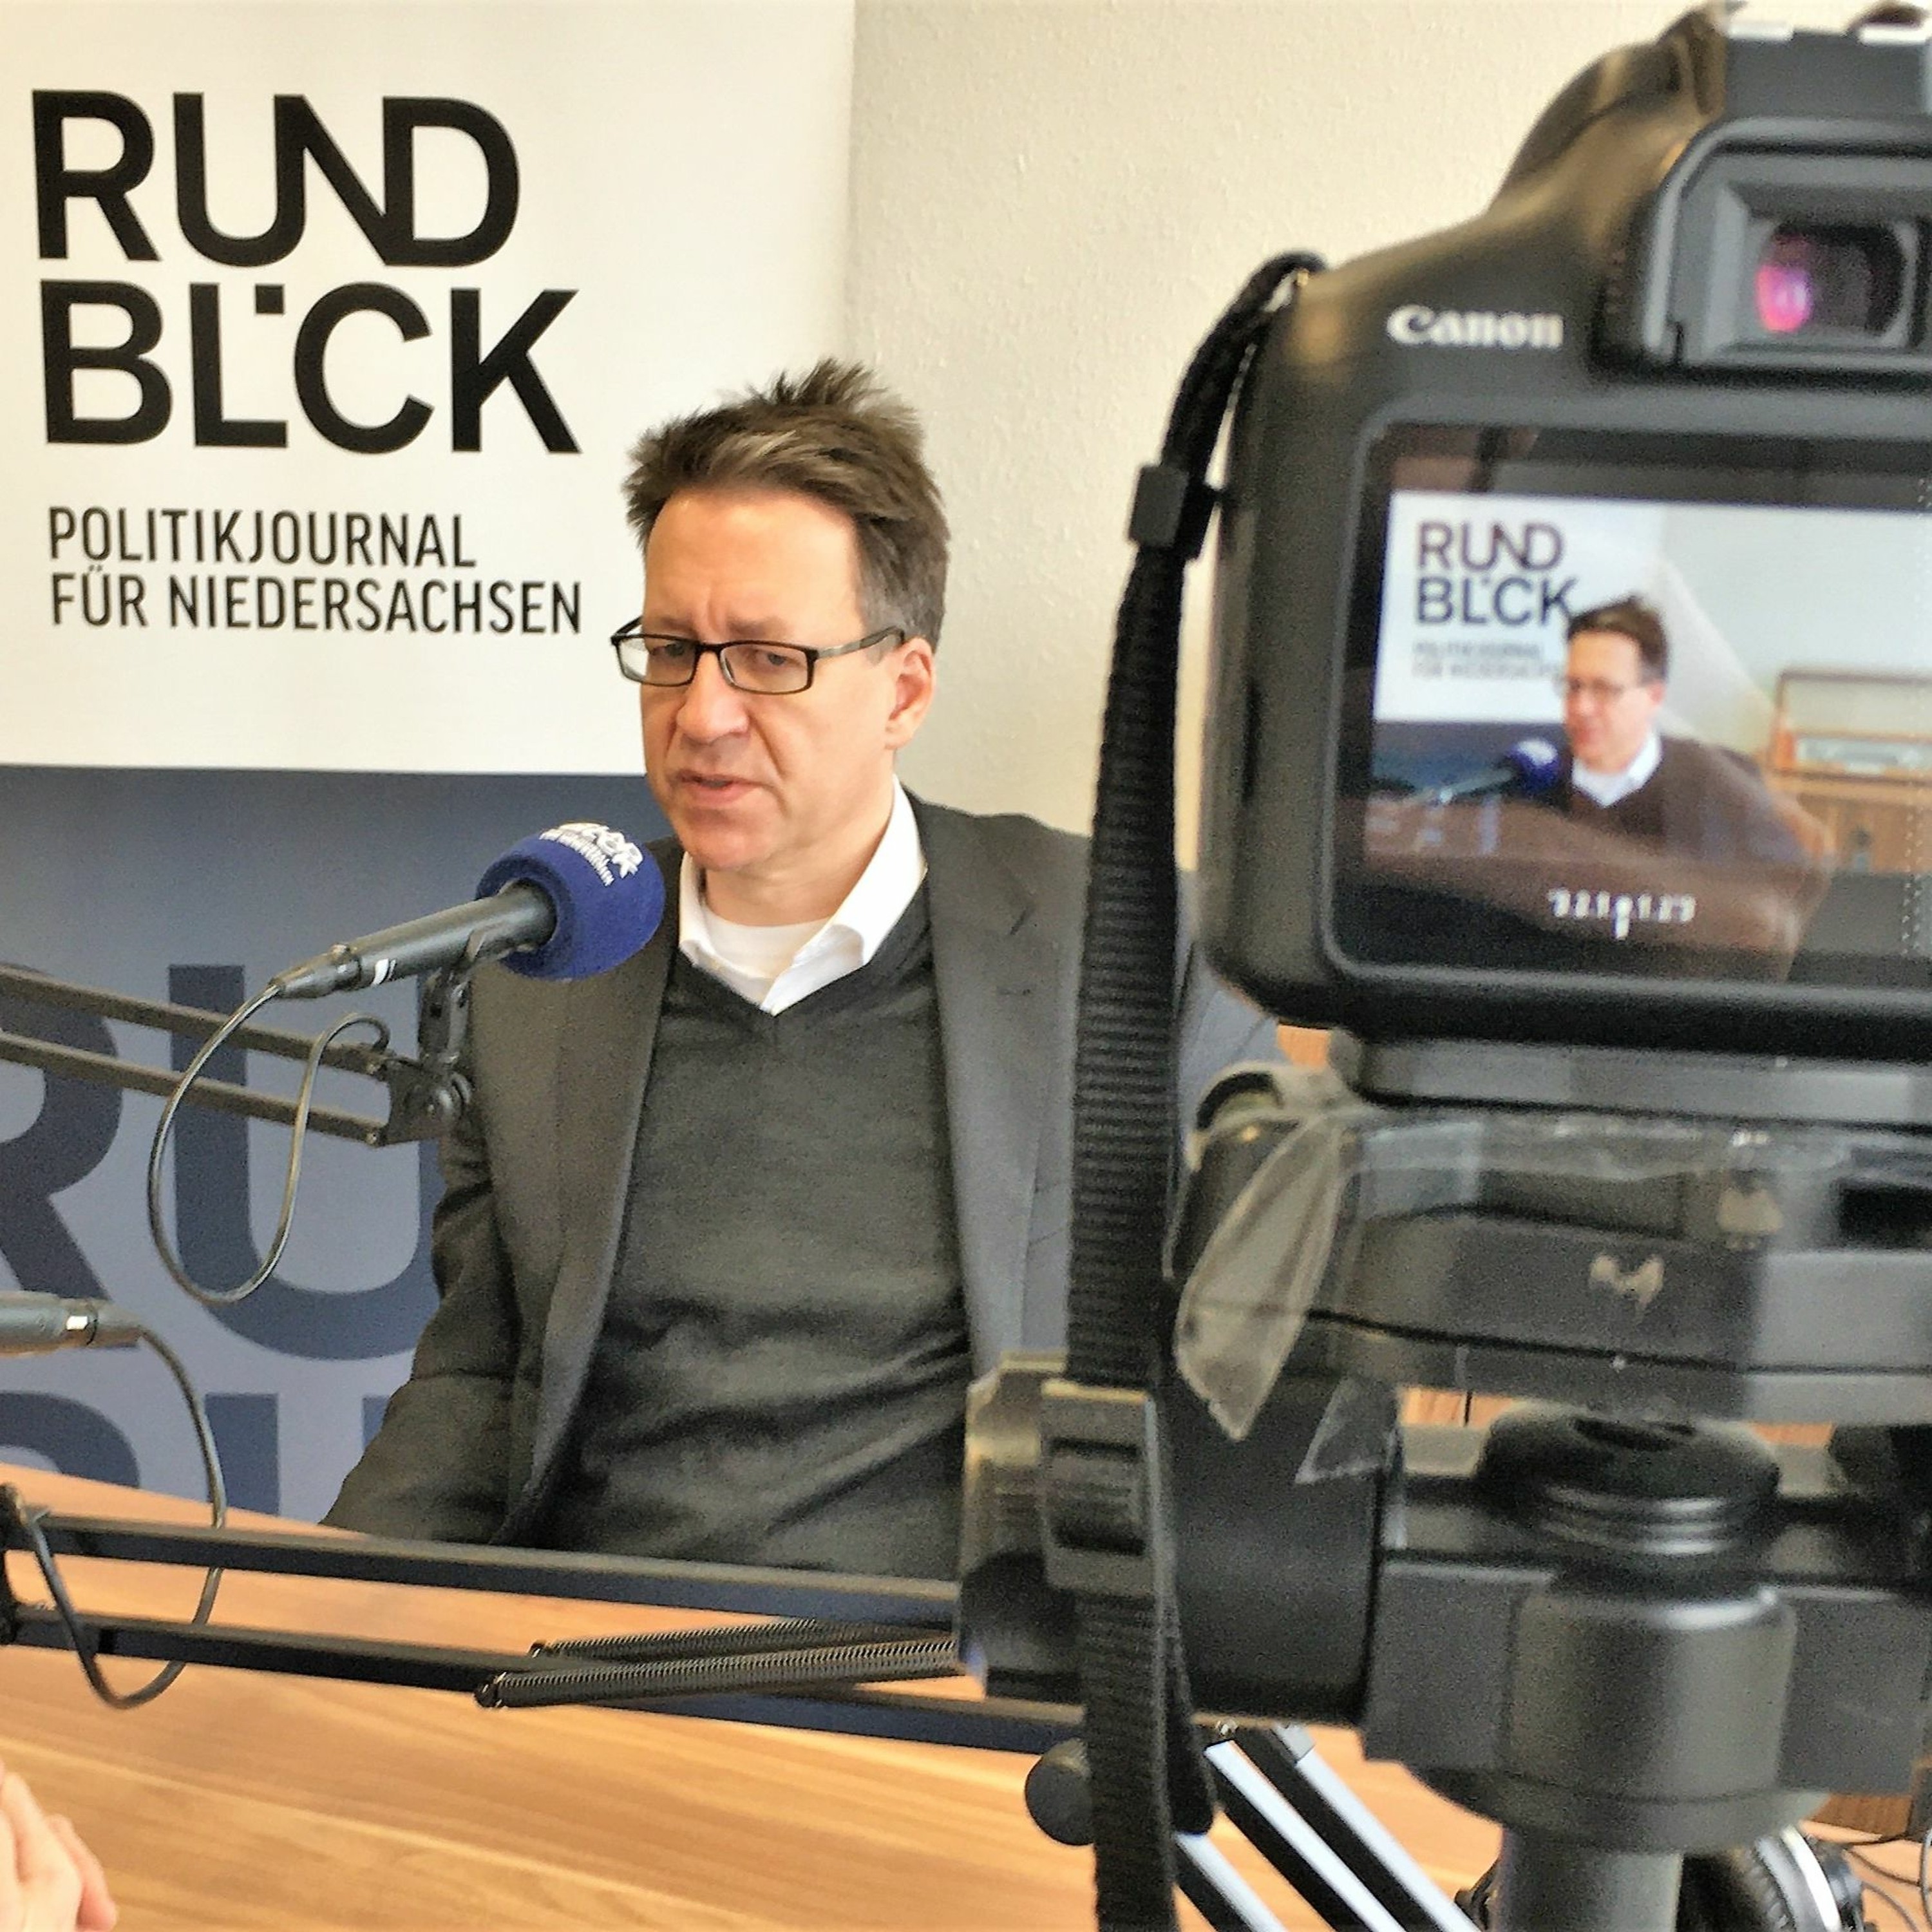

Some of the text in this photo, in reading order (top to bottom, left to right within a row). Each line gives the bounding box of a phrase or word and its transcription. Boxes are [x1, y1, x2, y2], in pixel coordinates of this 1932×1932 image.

[32, 90, 520, 267] RUND
[1387, 305, 1564, 350] Canon
[49, 506, 477, 568] POLITIKJOURNAL
[1417, 520, 1566, 572] RUND
[52, 564, 582, 634] FÜR NIEDERSACHSEN
